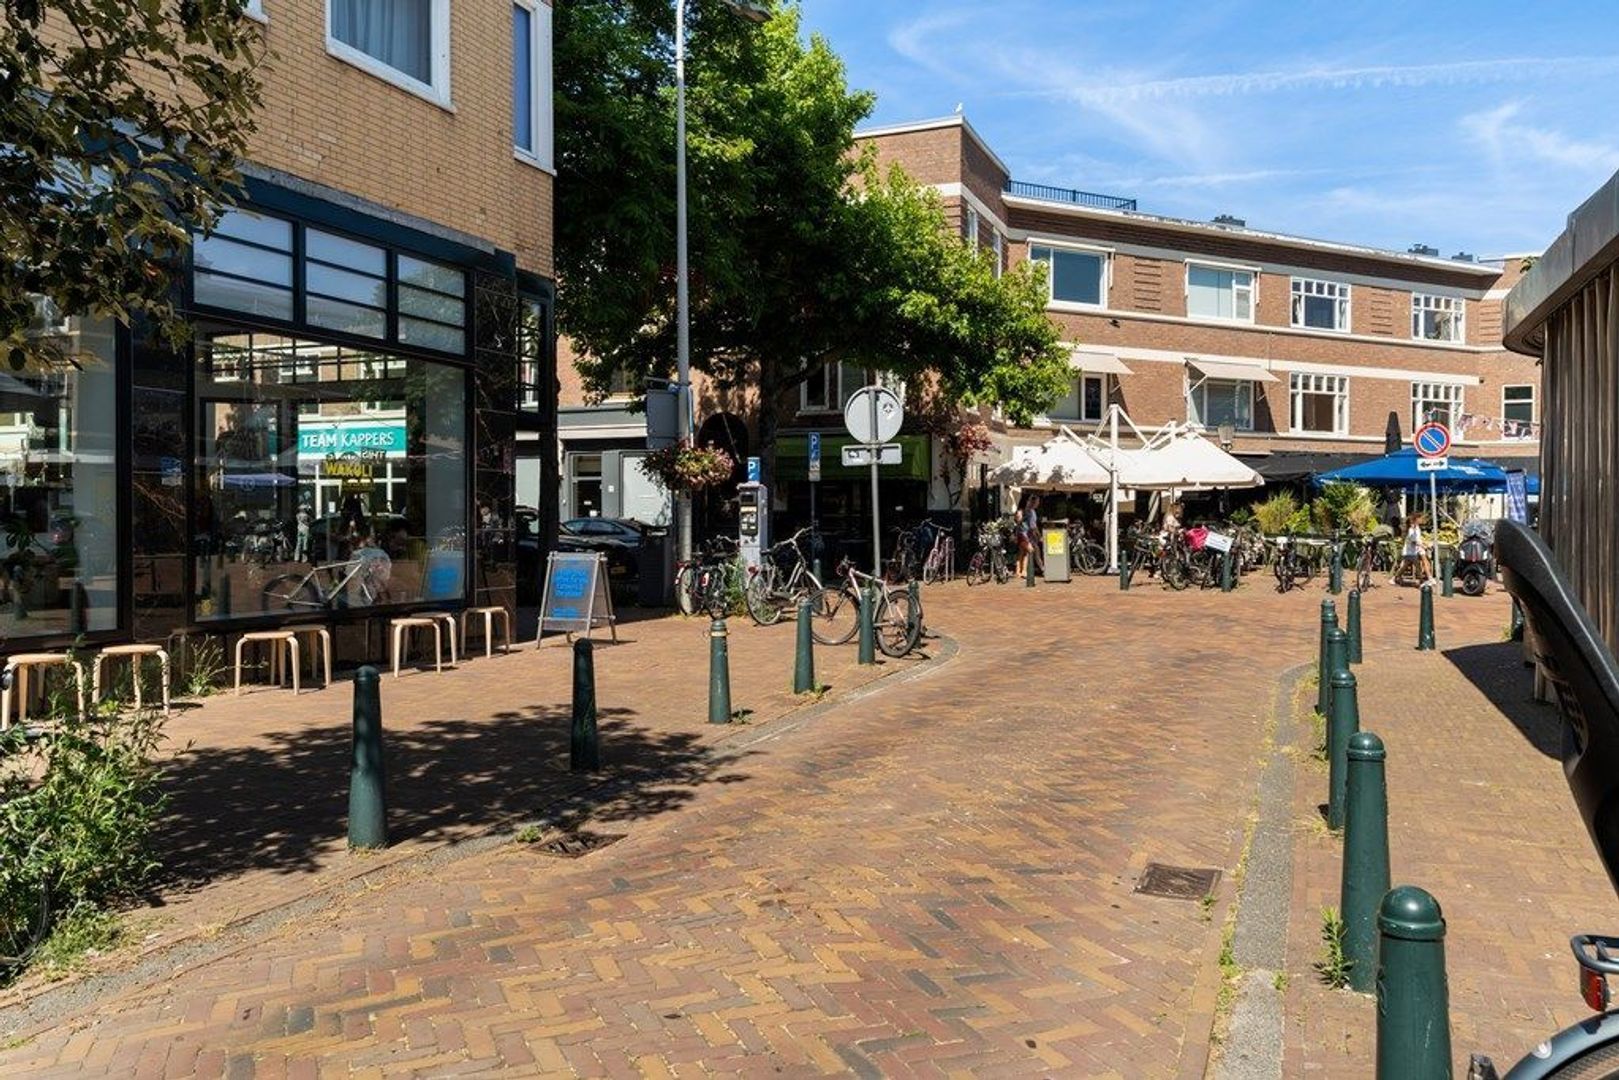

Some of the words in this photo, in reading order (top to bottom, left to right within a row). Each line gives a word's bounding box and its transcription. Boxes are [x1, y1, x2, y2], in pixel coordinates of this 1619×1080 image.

[302, 433, 337, 448] TEAM
[341, 431, 395, 447] KAPPERS
[810, 434, 818, 450] P
[747, 460, 756, 473] P
